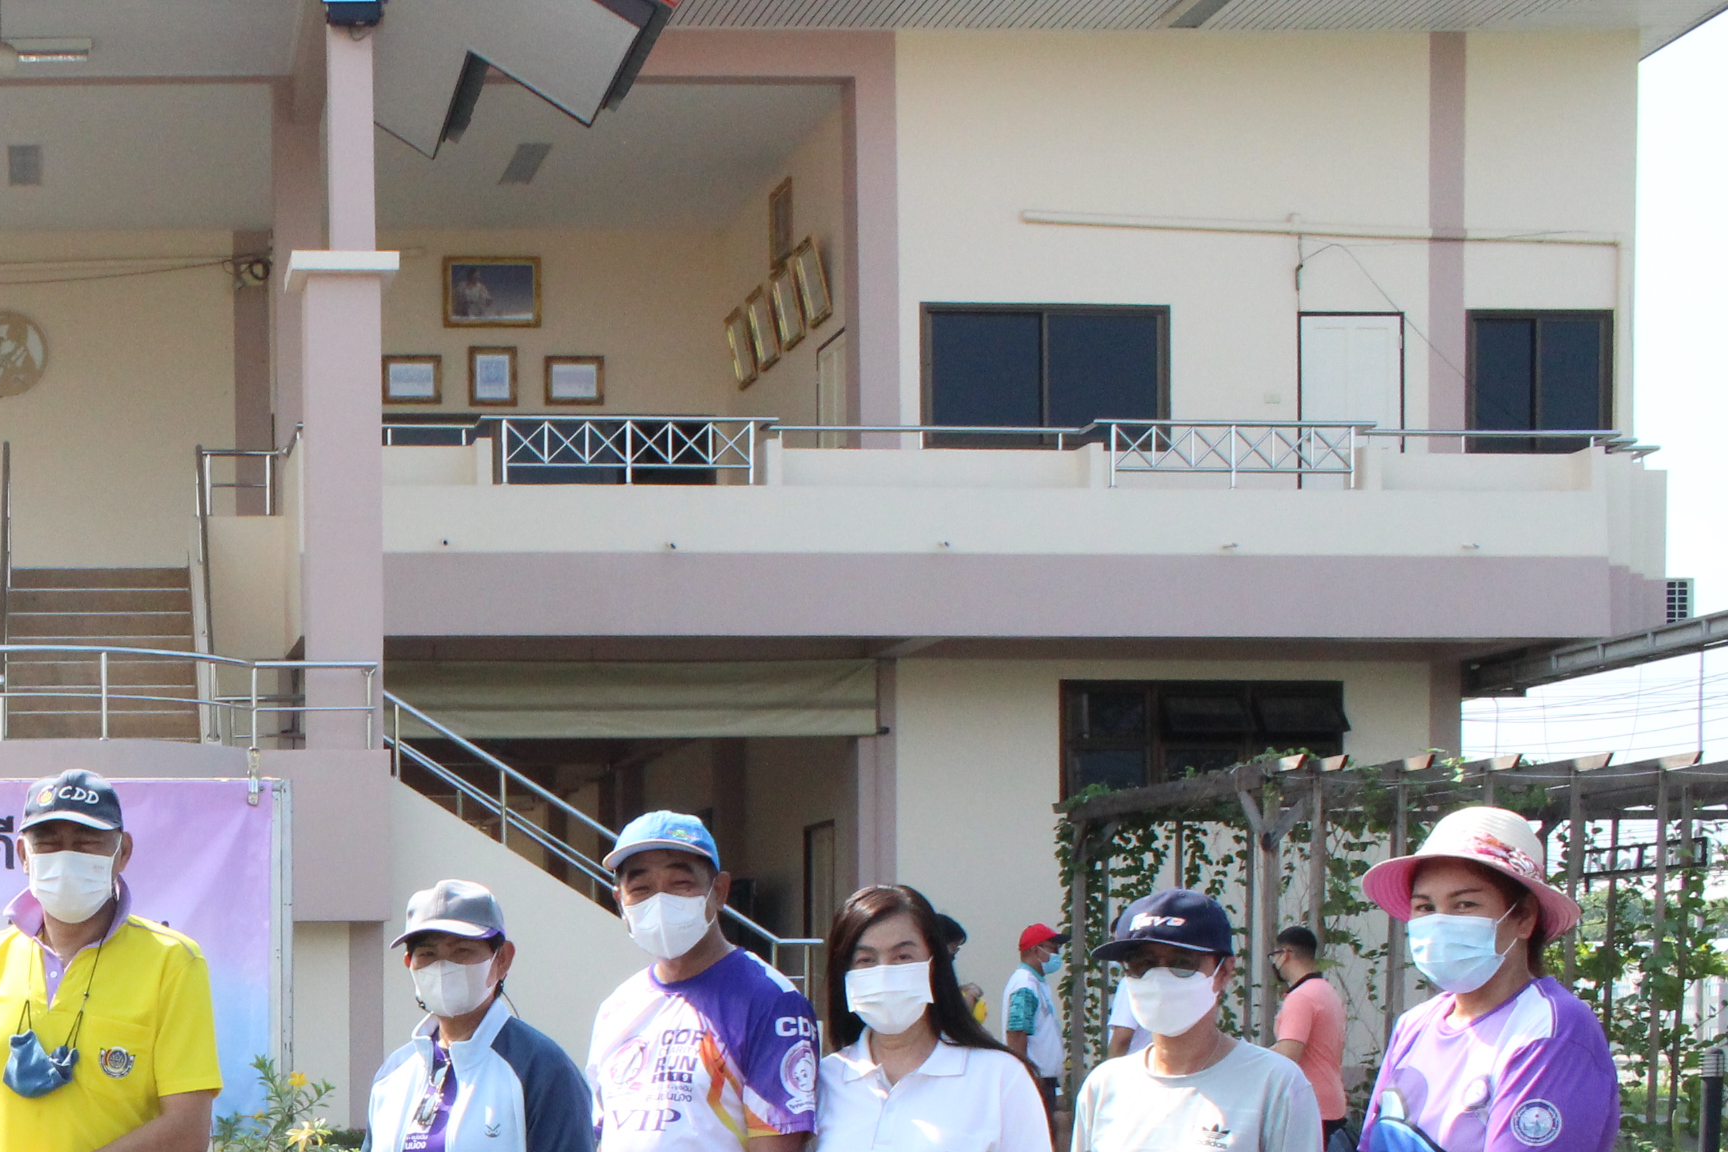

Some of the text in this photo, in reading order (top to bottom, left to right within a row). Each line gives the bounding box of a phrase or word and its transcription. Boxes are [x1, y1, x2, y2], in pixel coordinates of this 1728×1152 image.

[58, 785, 100, 805] CDD
[654, 1055, 699, 1073] RUN
[612, 1107, 682, 1132] VIP
